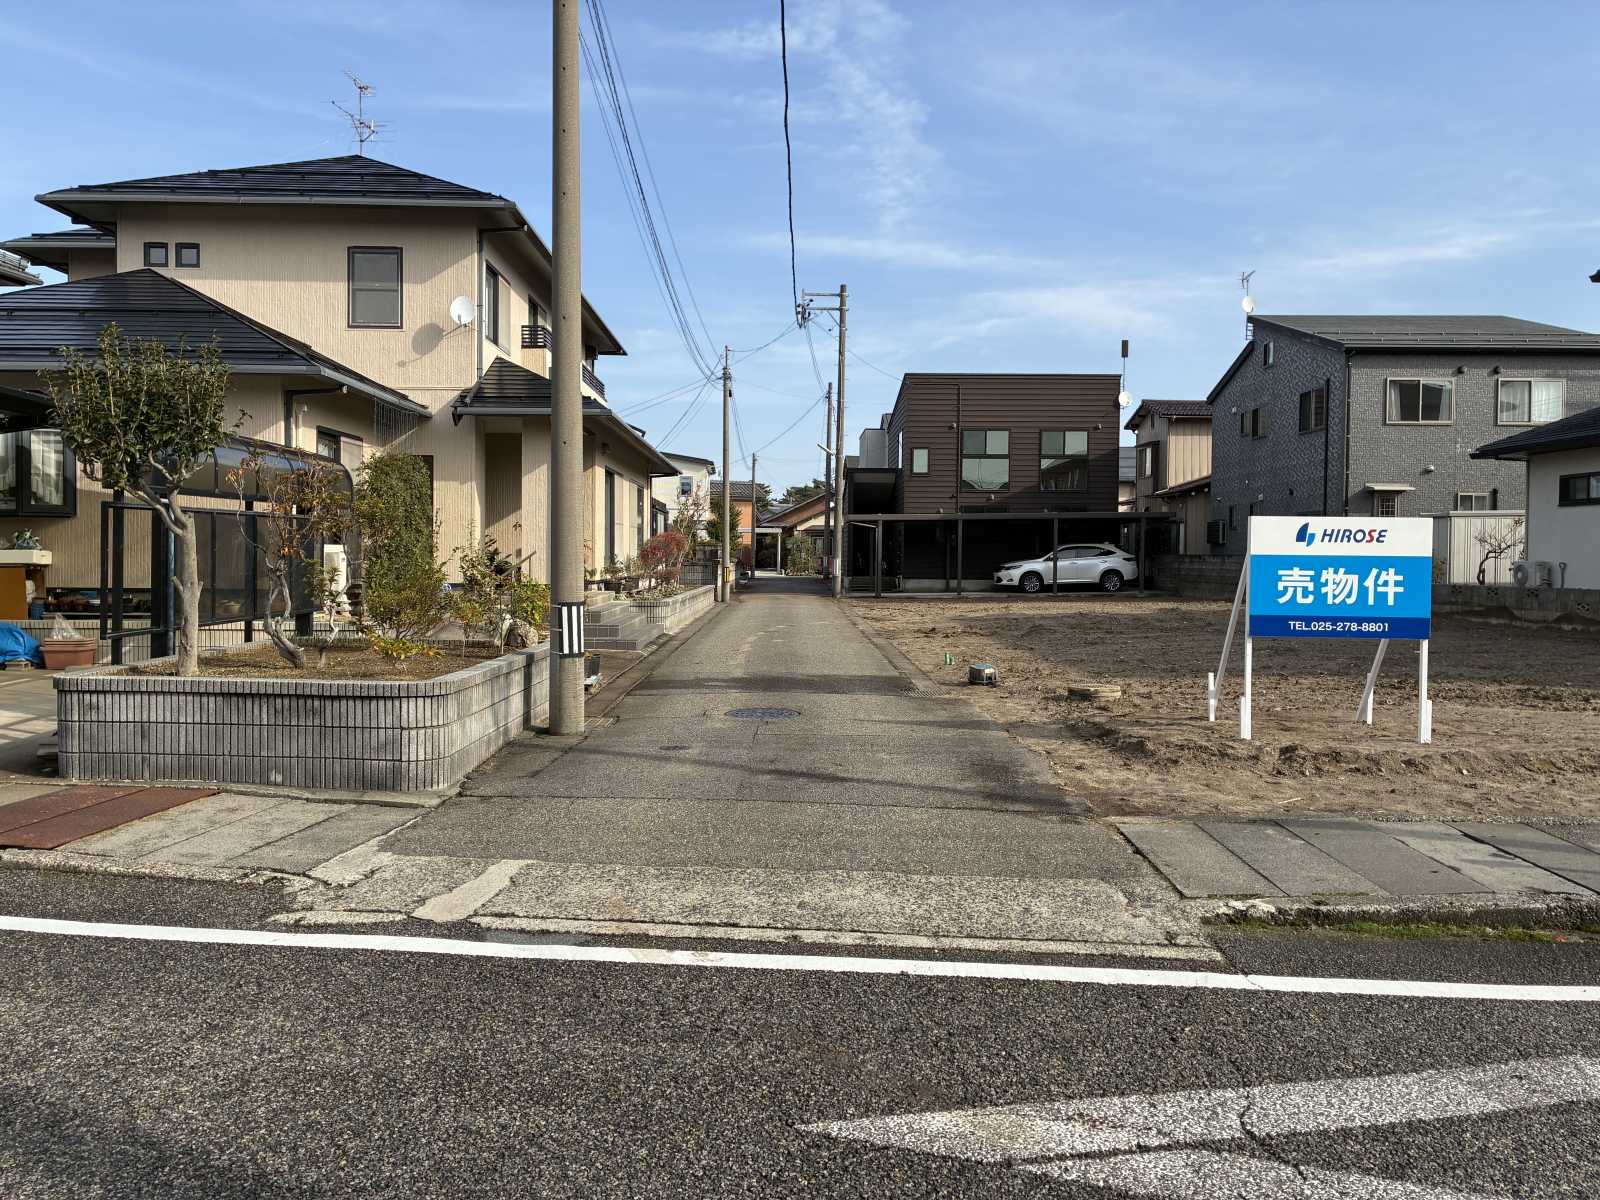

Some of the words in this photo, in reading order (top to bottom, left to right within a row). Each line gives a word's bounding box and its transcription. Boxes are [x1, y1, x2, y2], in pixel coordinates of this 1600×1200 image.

[1320, 528, 1388, 543] HIROSE
[1276, 567, 1405, 606] 売物件
